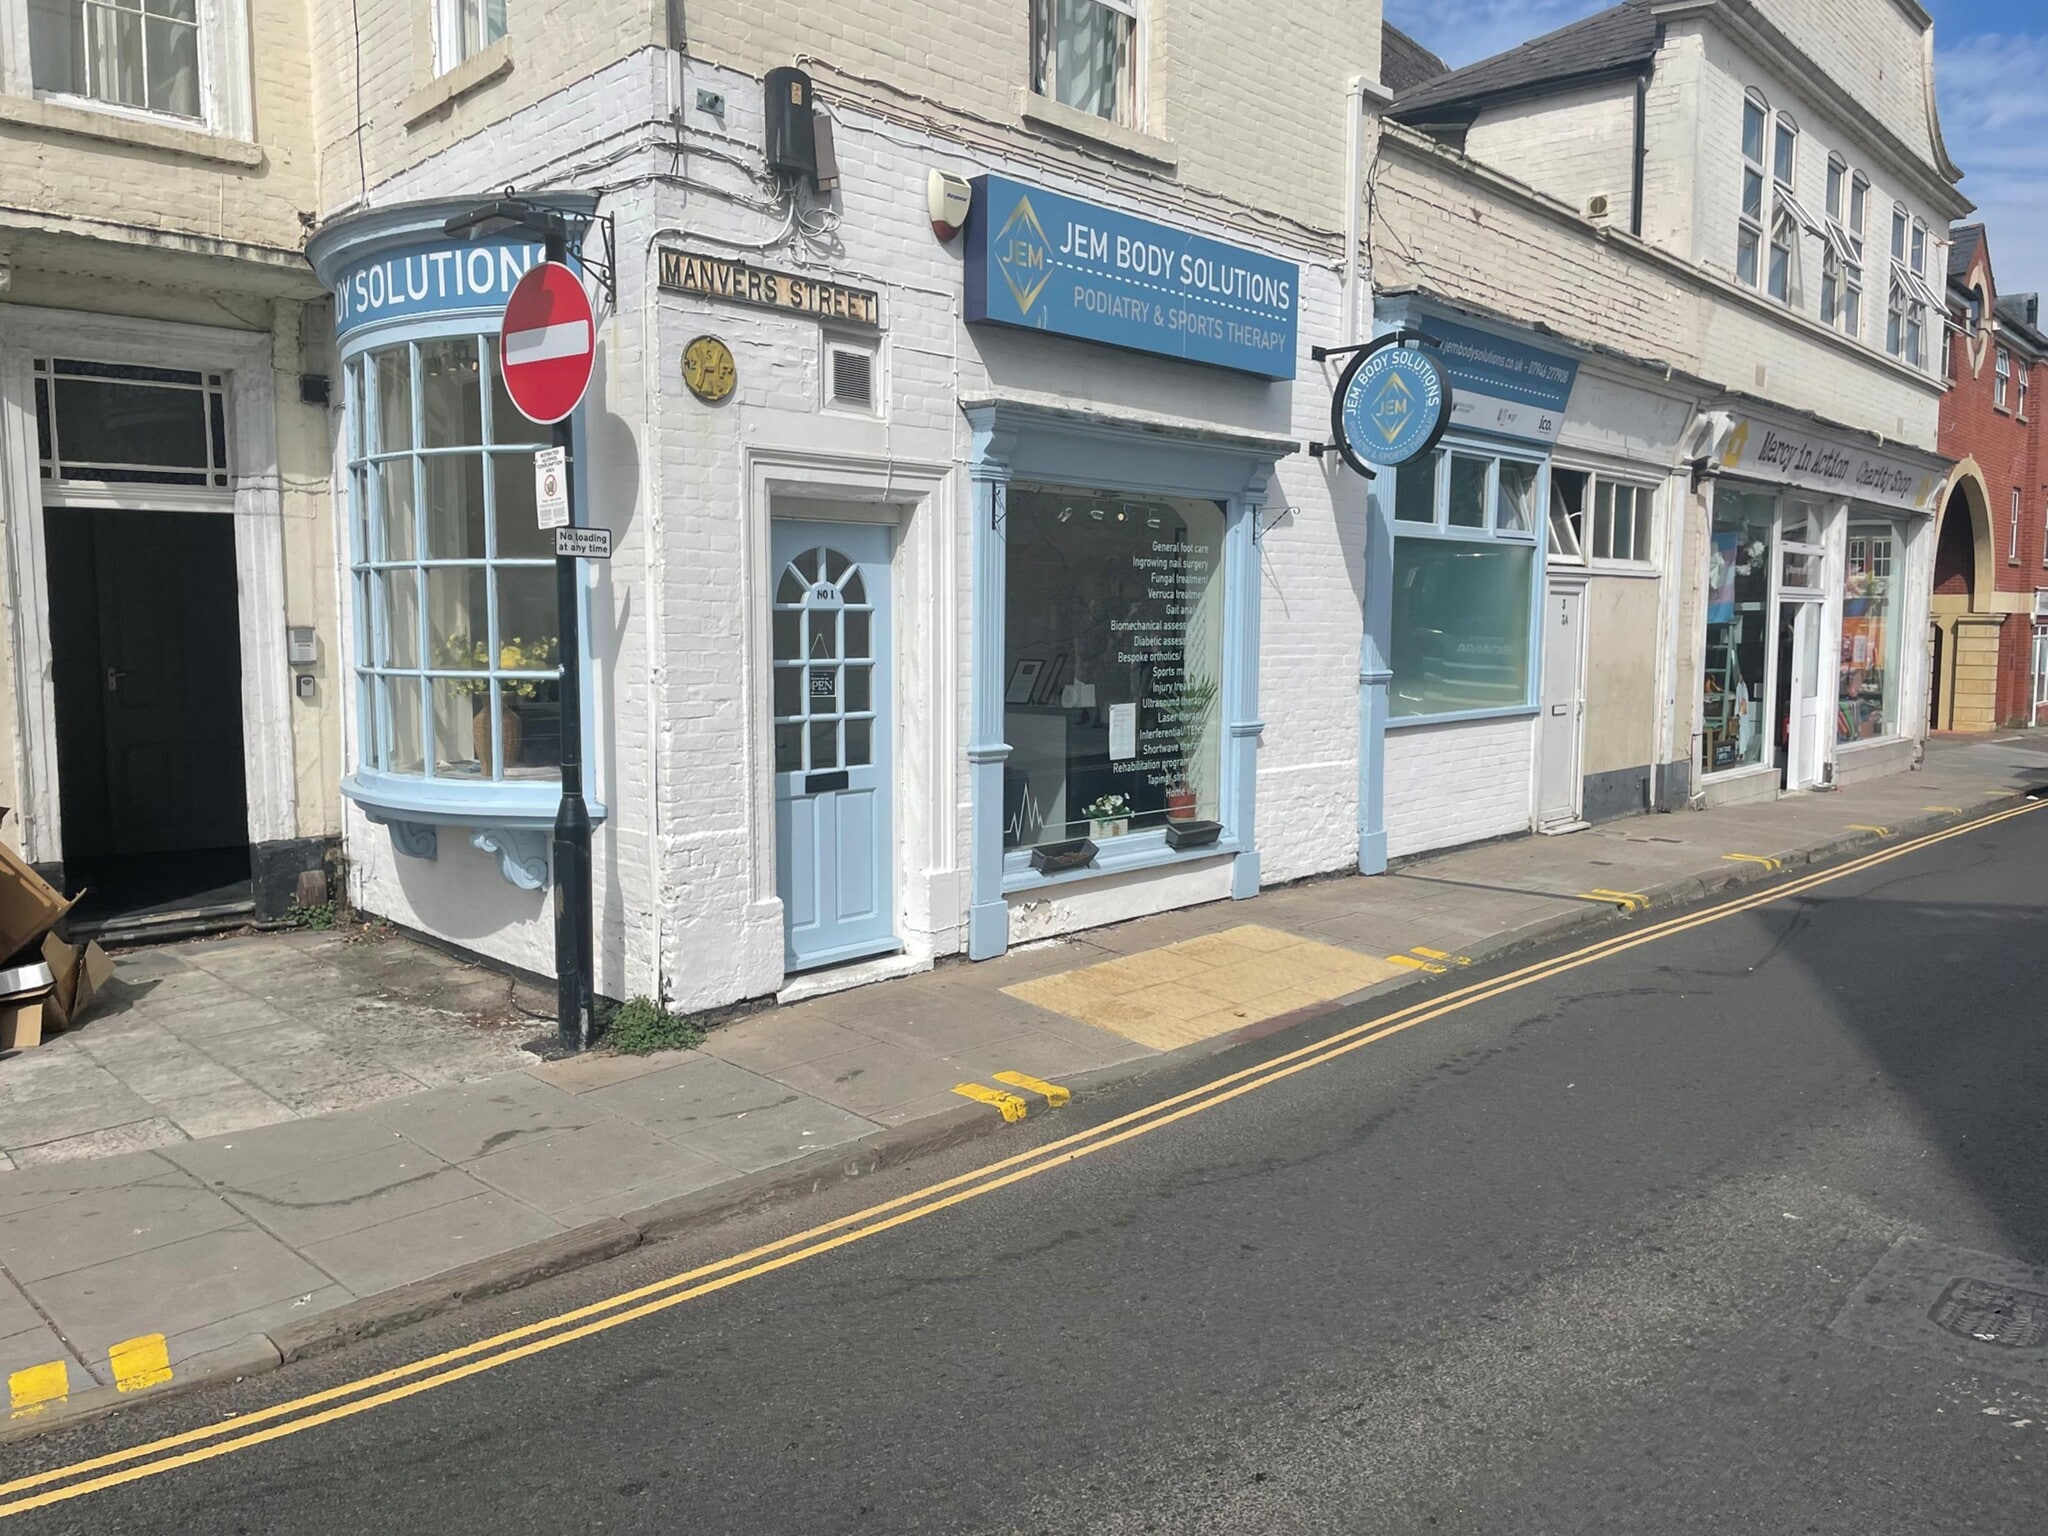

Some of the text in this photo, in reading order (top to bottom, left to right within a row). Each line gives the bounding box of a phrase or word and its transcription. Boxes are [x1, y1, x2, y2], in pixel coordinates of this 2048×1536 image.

[1003, 239, 1043, 270] JEM
[1060, 222, 1290, 310] JEM BODY SOLUTIONS
[664, 253, 873, 322] MANVERS STREET
[1074, 285, 1287, 353] PODIATRY & SPORTS THERAPY
[1424, 336, 1524, 371] .jembodysolutions.co.uk
[1346, 351, 1439, 416] JEM BODY SOLUTIONS
[1376, 398, 1407, 416] JEM
[1757, 430, 1912, 499] Mercy in Action Charity Shop
[560, 531, 607, 545] No loading
[559, 543, 608, 553] at any time
[1152, 541, 1209, 554] General foot care
[1133, 556, 1209, 572] Ingrowing nail surgery
[1151, 572, 1175, 586] Fungal
[817, 590, 828, 600] NO
[1148, 588, 1174, 599] Verruca
[1165, 604, 1179, 615] Gait
[1110, 619, 1162, 631] Biomechanical
[1134, 635, 1161, 647] Diabetic
[1118, 651, 1148, 665] Bespoke
[1153, 666, 1175, 679] Sports
[809, 680, 833, 691] PEN
[1152, 682, 1173, 695] Injury
[1142, 695, 1180, 709] Ultrasound
[1157, 712, 1178, 723] Laser
[1143, 743, 1179, 755] Shortwave
[1113, 759, 1160, 773] Rehabilitation
